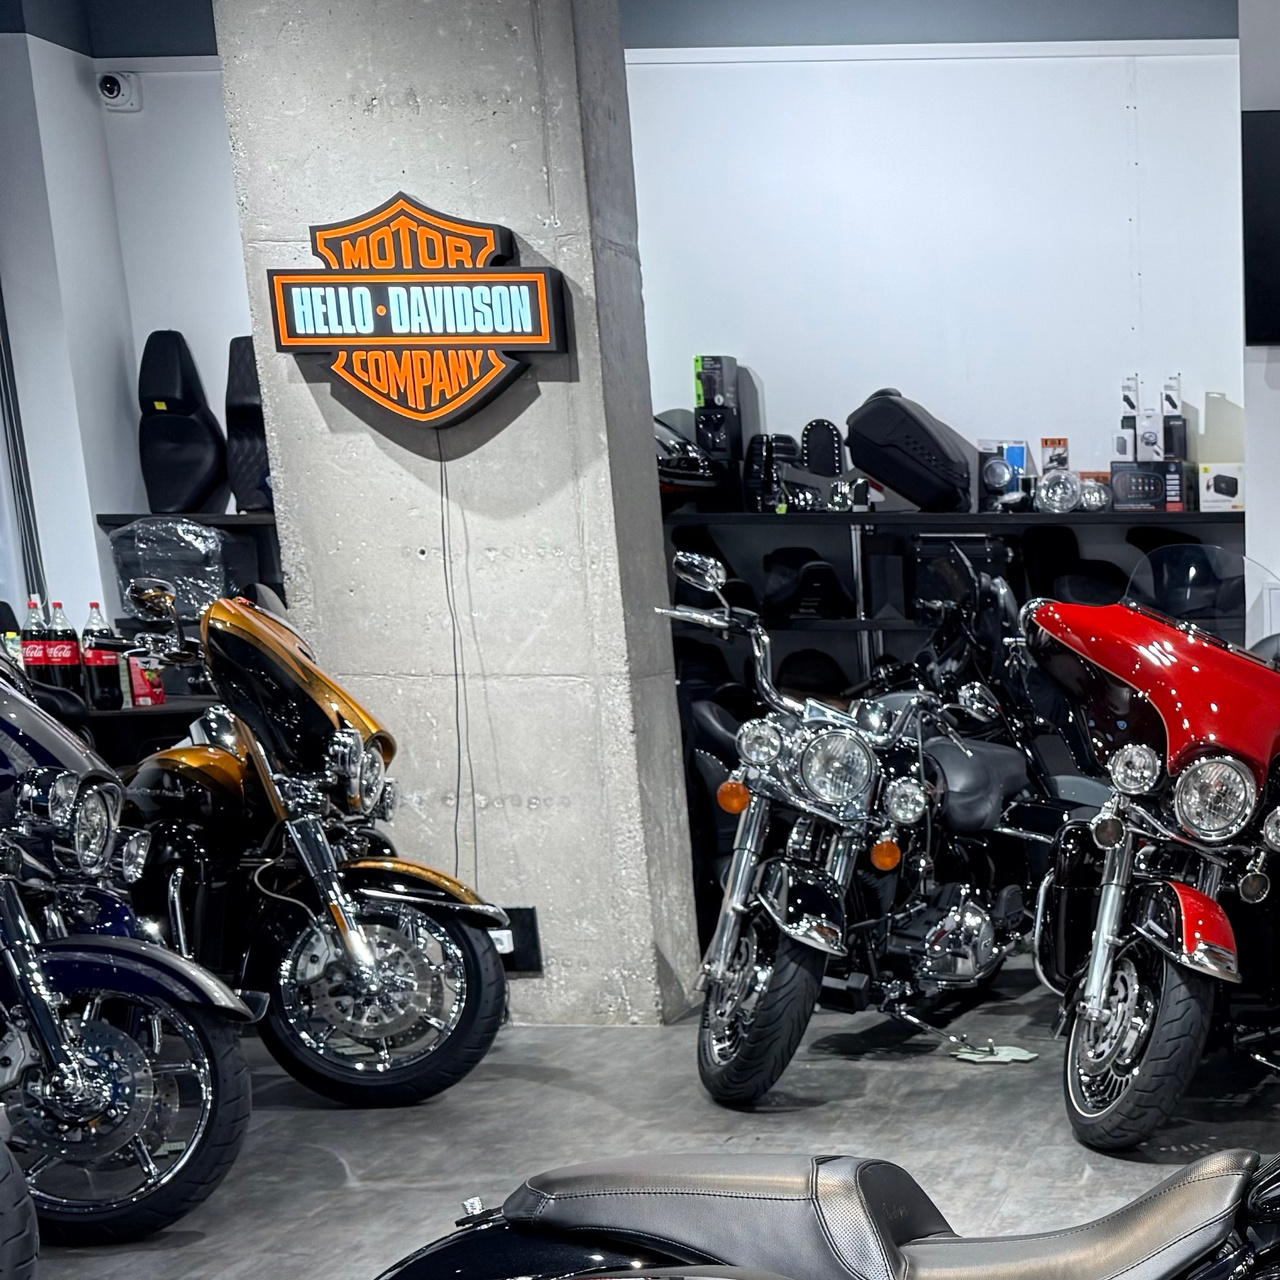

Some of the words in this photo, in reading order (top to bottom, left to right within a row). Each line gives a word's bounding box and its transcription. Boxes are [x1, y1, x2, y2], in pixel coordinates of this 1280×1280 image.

[340, 215, 473, 269] MOTOR
[291, 286, 374, 334] HELLO
[387, 285, 533, 333] DAVIDSON
[352, 350, 484, 410] COMPANY
